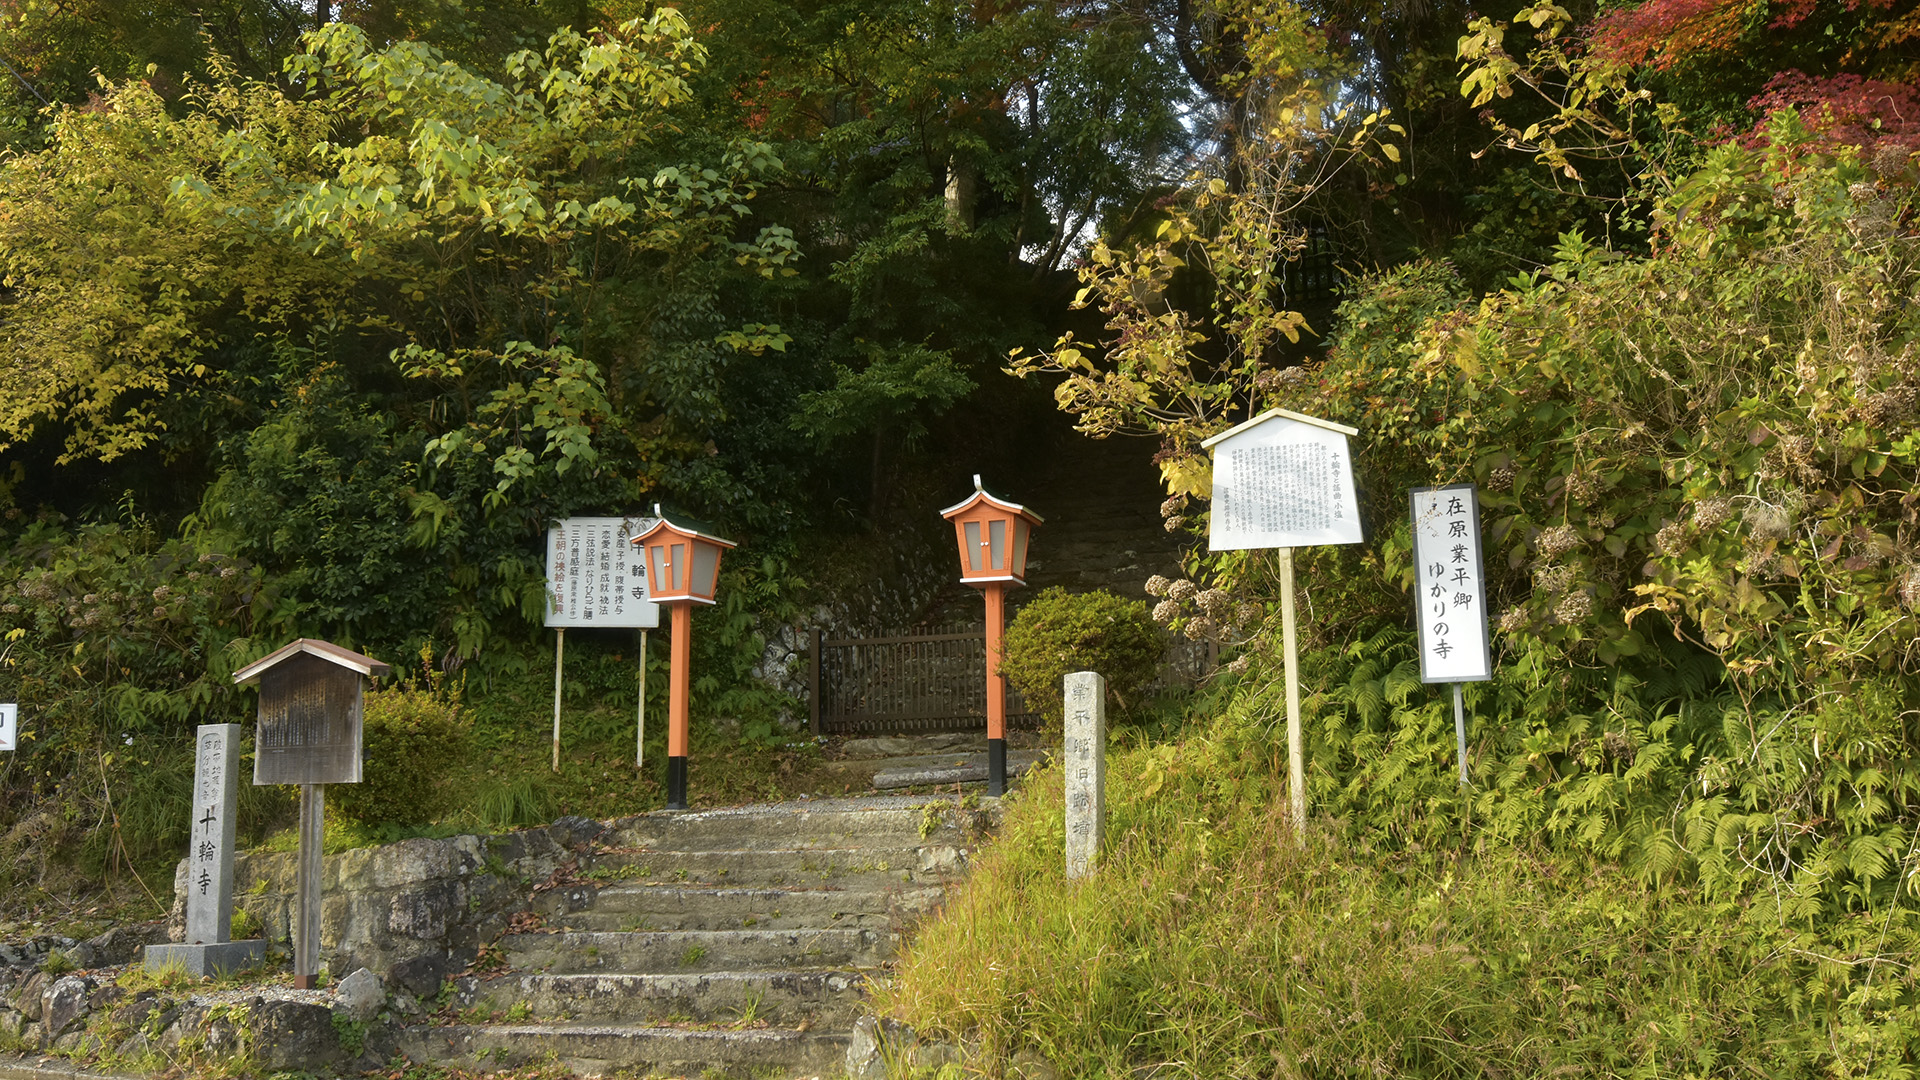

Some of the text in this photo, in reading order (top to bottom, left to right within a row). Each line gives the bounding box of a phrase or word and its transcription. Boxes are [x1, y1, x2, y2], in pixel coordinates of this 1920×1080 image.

[1445, 496, 1473, 611] 在原業平卿
[1428, 561, 1454, 660] ゆかりの寺
[197, 808, 217, 896] 十輪寺
